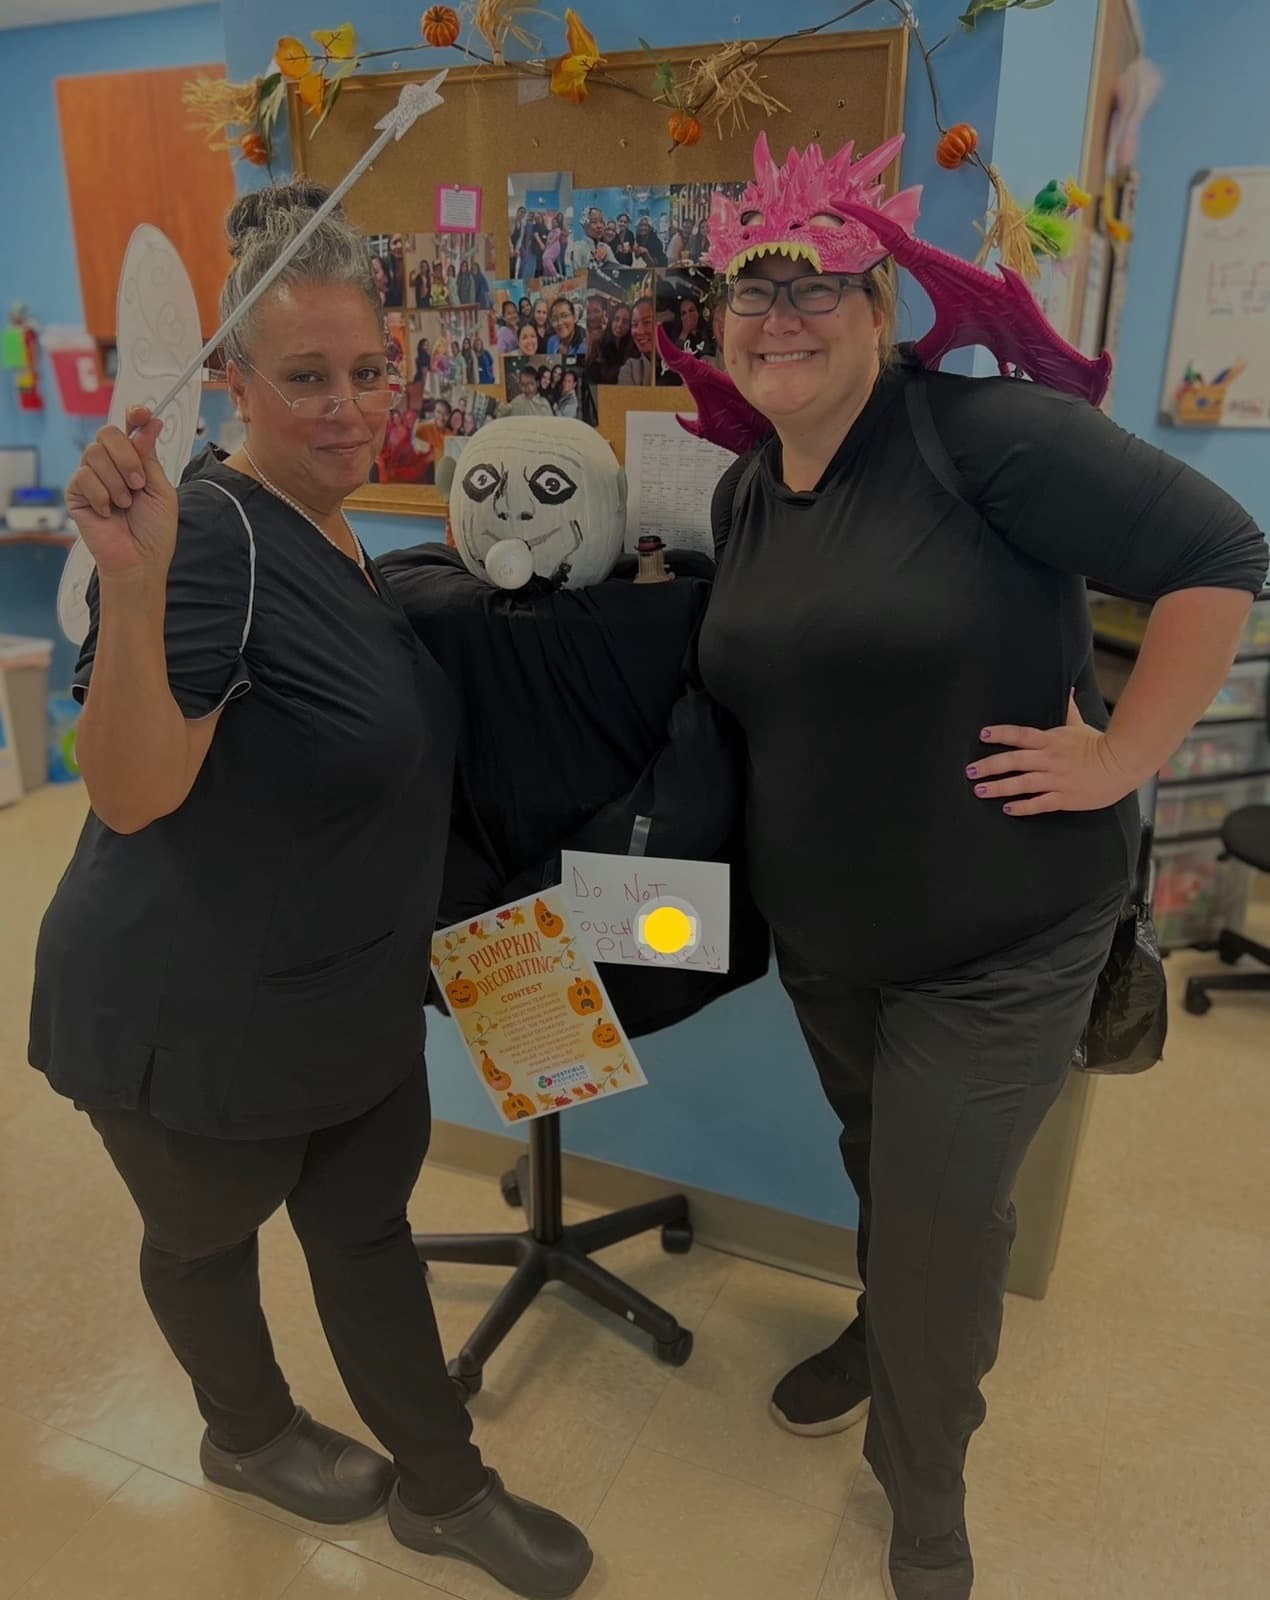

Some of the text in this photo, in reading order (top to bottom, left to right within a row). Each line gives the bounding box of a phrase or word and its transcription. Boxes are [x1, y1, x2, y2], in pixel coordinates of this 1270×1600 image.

[572, 865, 603, 898] Do
[572, 909, 634, 936] OUCH
[467, 931, 542, 975] PUMPKIN
[475, 955, 555, 997] DECORATING
[500, 982, 544, 1004] CONTEST
